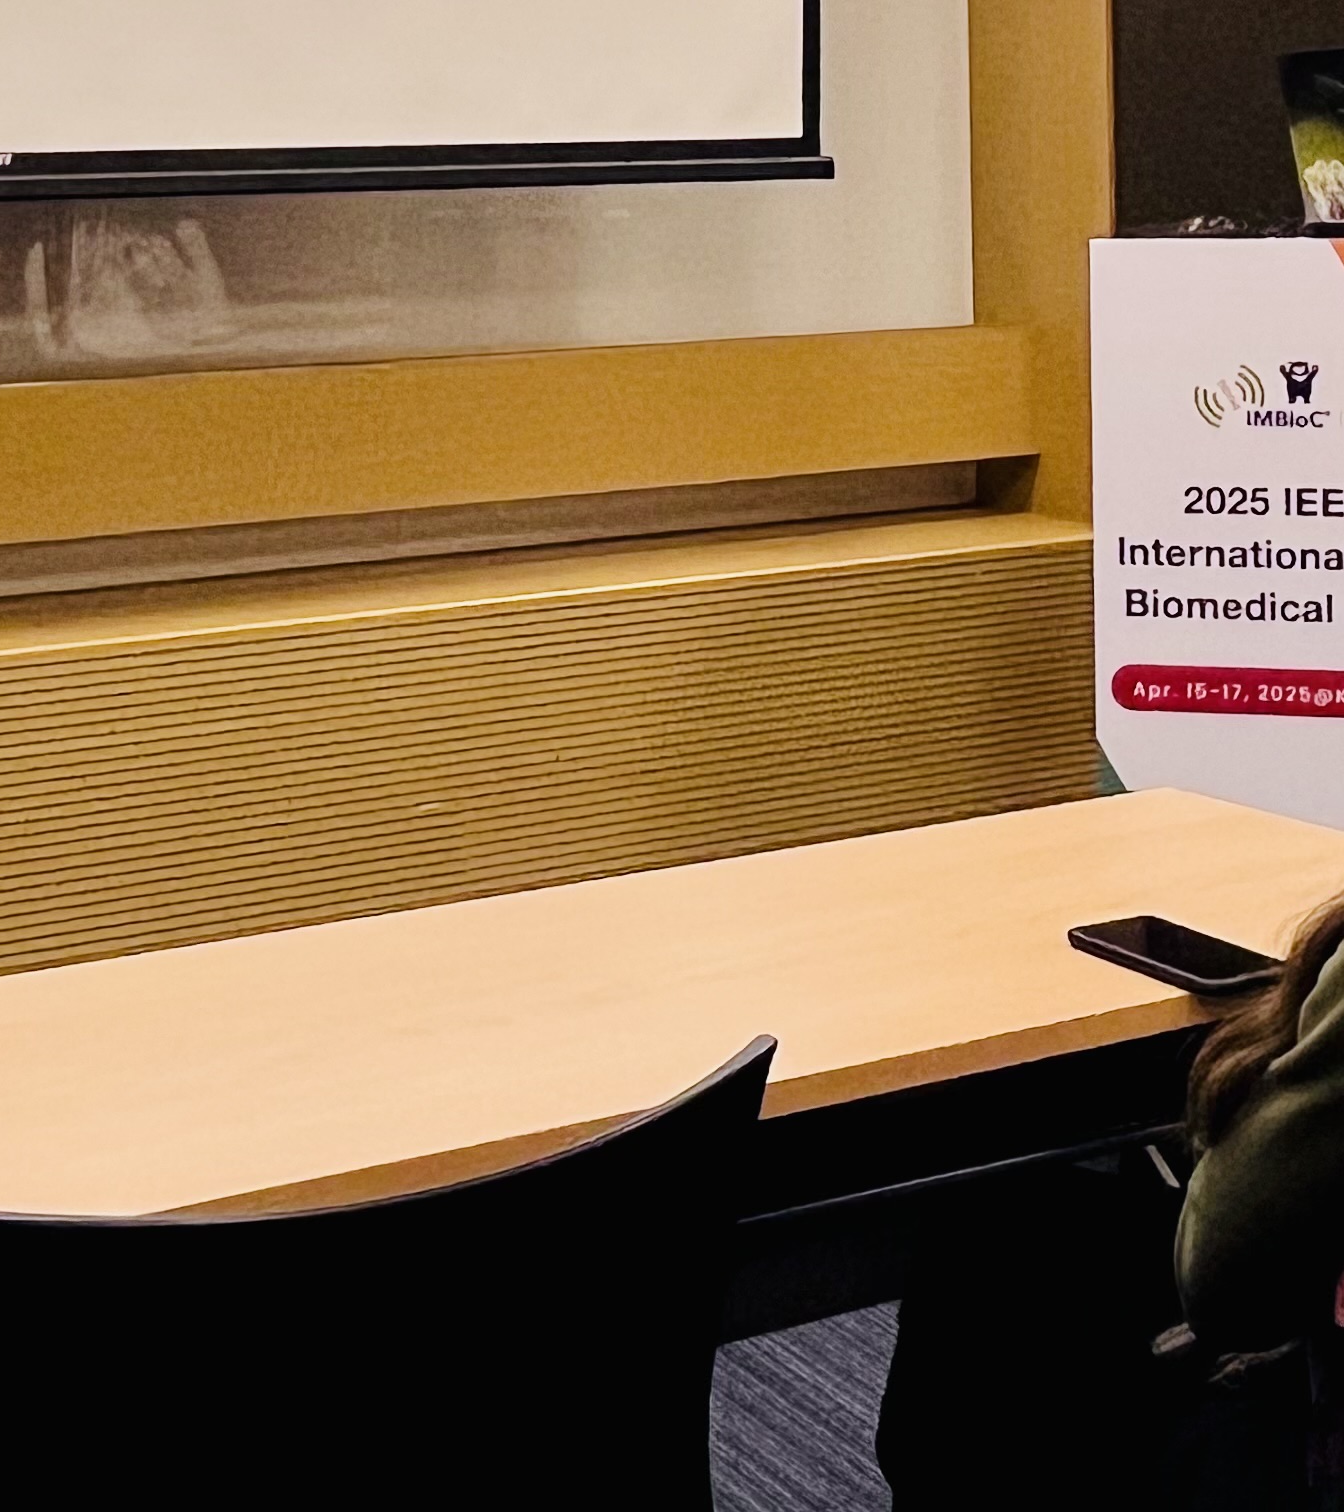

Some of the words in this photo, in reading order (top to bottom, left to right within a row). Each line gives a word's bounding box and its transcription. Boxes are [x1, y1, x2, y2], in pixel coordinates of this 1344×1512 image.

[1183, 486, 1270, 517] 2025
[1126, 589, 1333, 624] Biomedical
[1187, 682, 1250, 704] 15-17,
